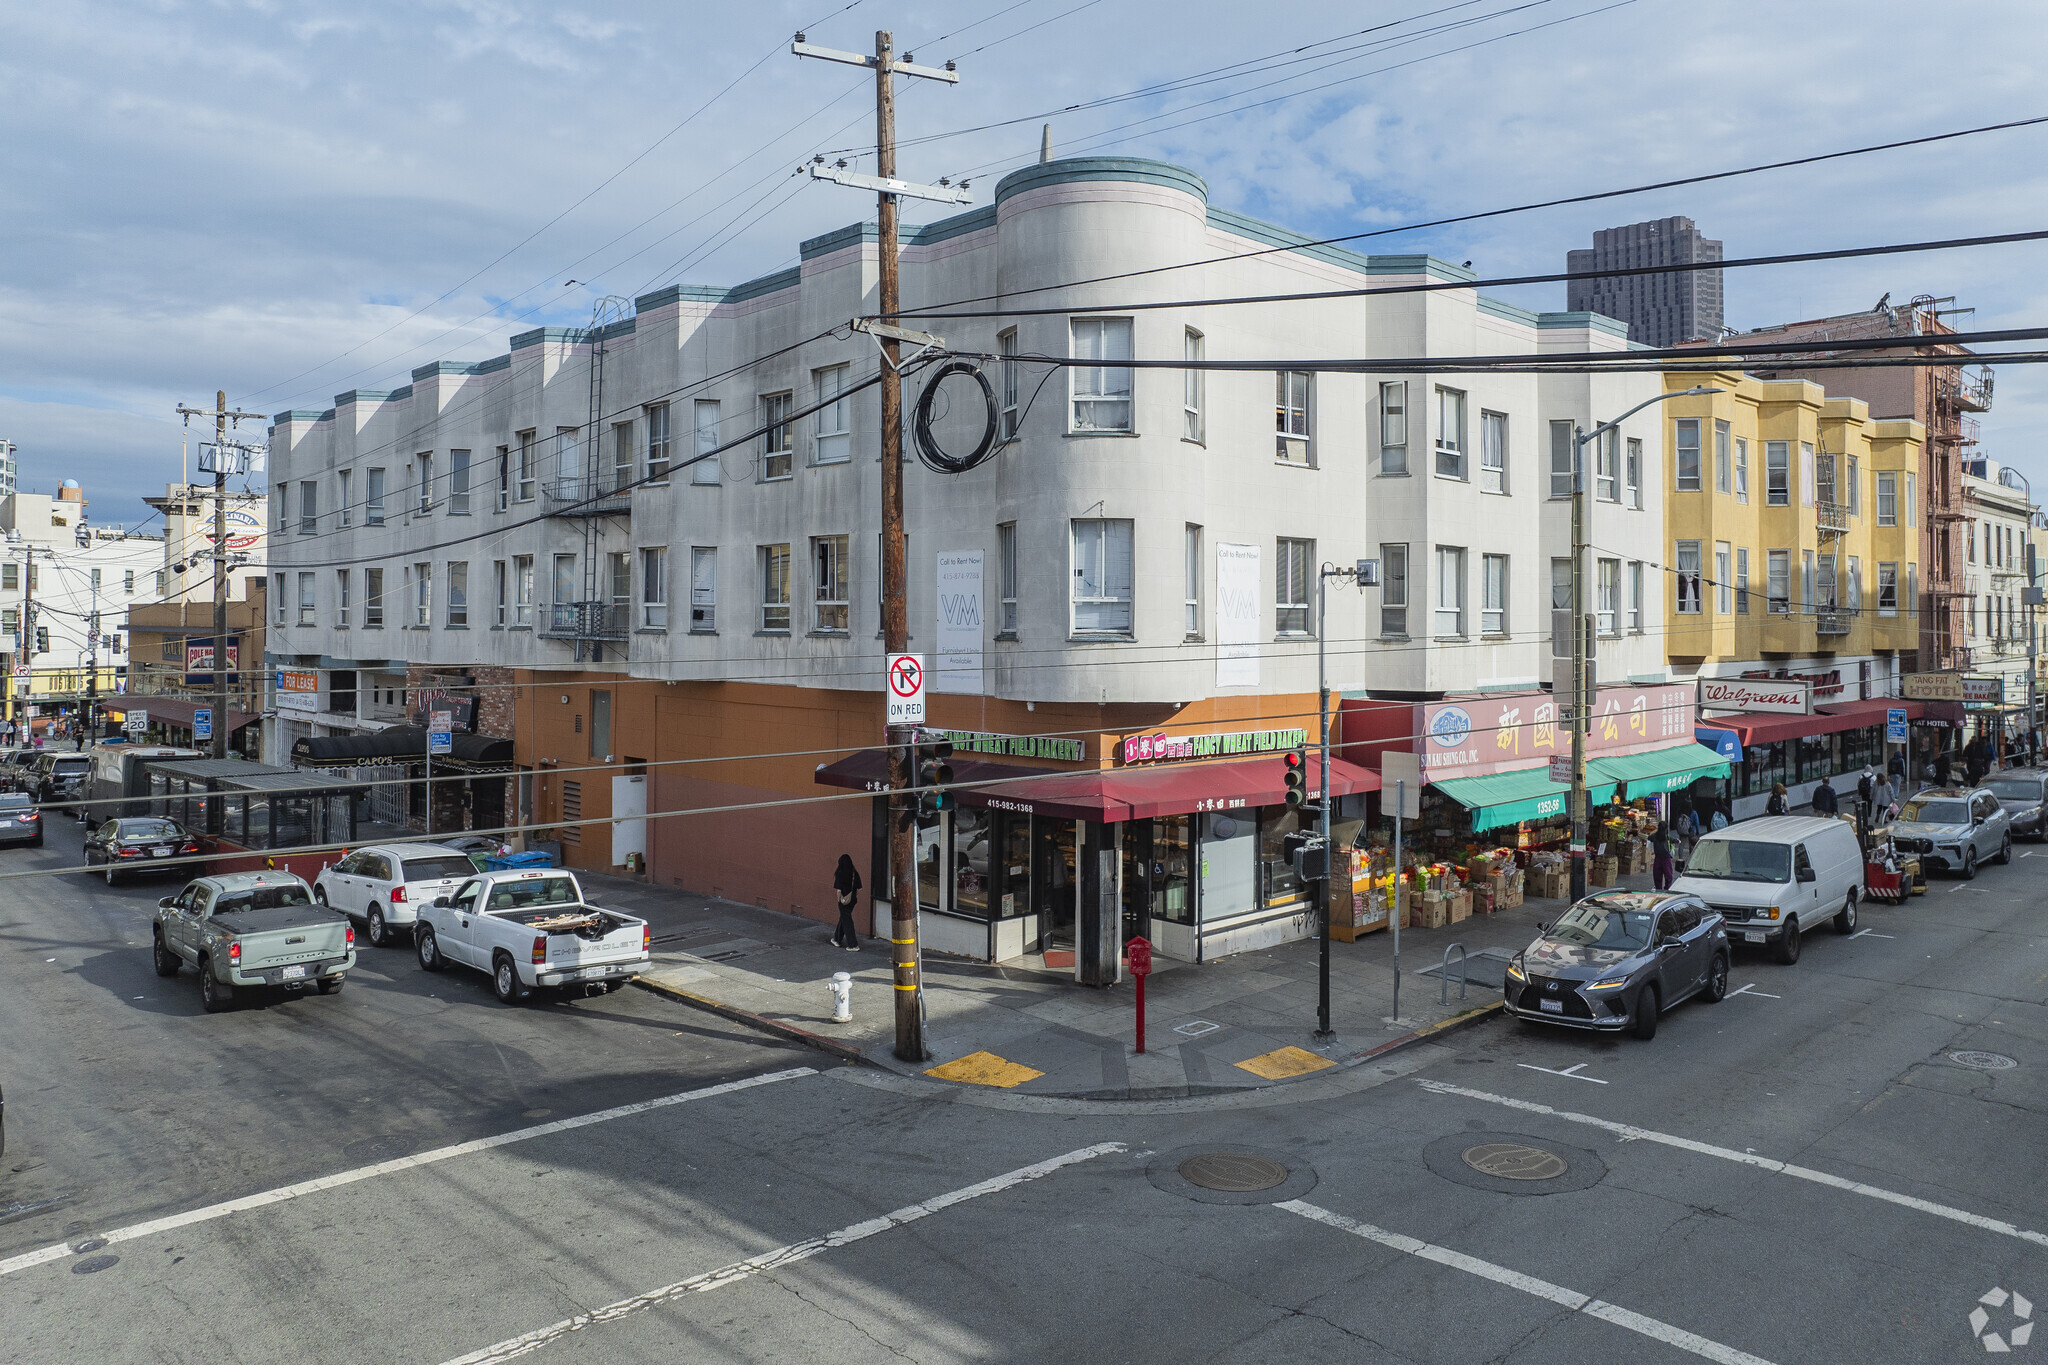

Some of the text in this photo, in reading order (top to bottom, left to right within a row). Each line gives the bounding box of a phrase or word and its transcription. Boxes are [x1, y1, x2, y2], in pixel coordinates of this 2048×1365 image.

[1219, 550, 1228, 558] Call
[1220, 586, 1256, 619] VM
[941, 594, 979, 626] VM
[190, 648, 203, 663] COLE
[285, 676, 295, 688] FOR
[297, 677, 314, 690] LEASE
[1914, 676, 1948, 684] TANG FAT
[1705, 685, 1801, 707] Walgreens
[1910, 686, 1960, 697] HOTEL
[891, 703, 922, 715] ON RED
[130, 721, 145, 730] 20
[974, 733, 1006, 754] WHEAT
[1009, 737, 1036, 757] FIELD
[1037, 740, 1078, 761] BAKERY
[1193, 729, 1308, 756] FANCY WHEAT FIELD BAKERY
[357, 756, 393, 766] CAPO'S
[1421, 752, 1431, 767] SUN
[1432, 752, 1442, 767] KAU
[1443, 751, 1458, 766] SHING
[1469, 749, 1479, 763] INC.
[987, 799, 1033, 813] 415-982-1368
[1537, 799, 1560, 814] 1352-56
[552, 940, 638, 956] CHEVROLET
[265, 951, 325, 962] TACOMA
